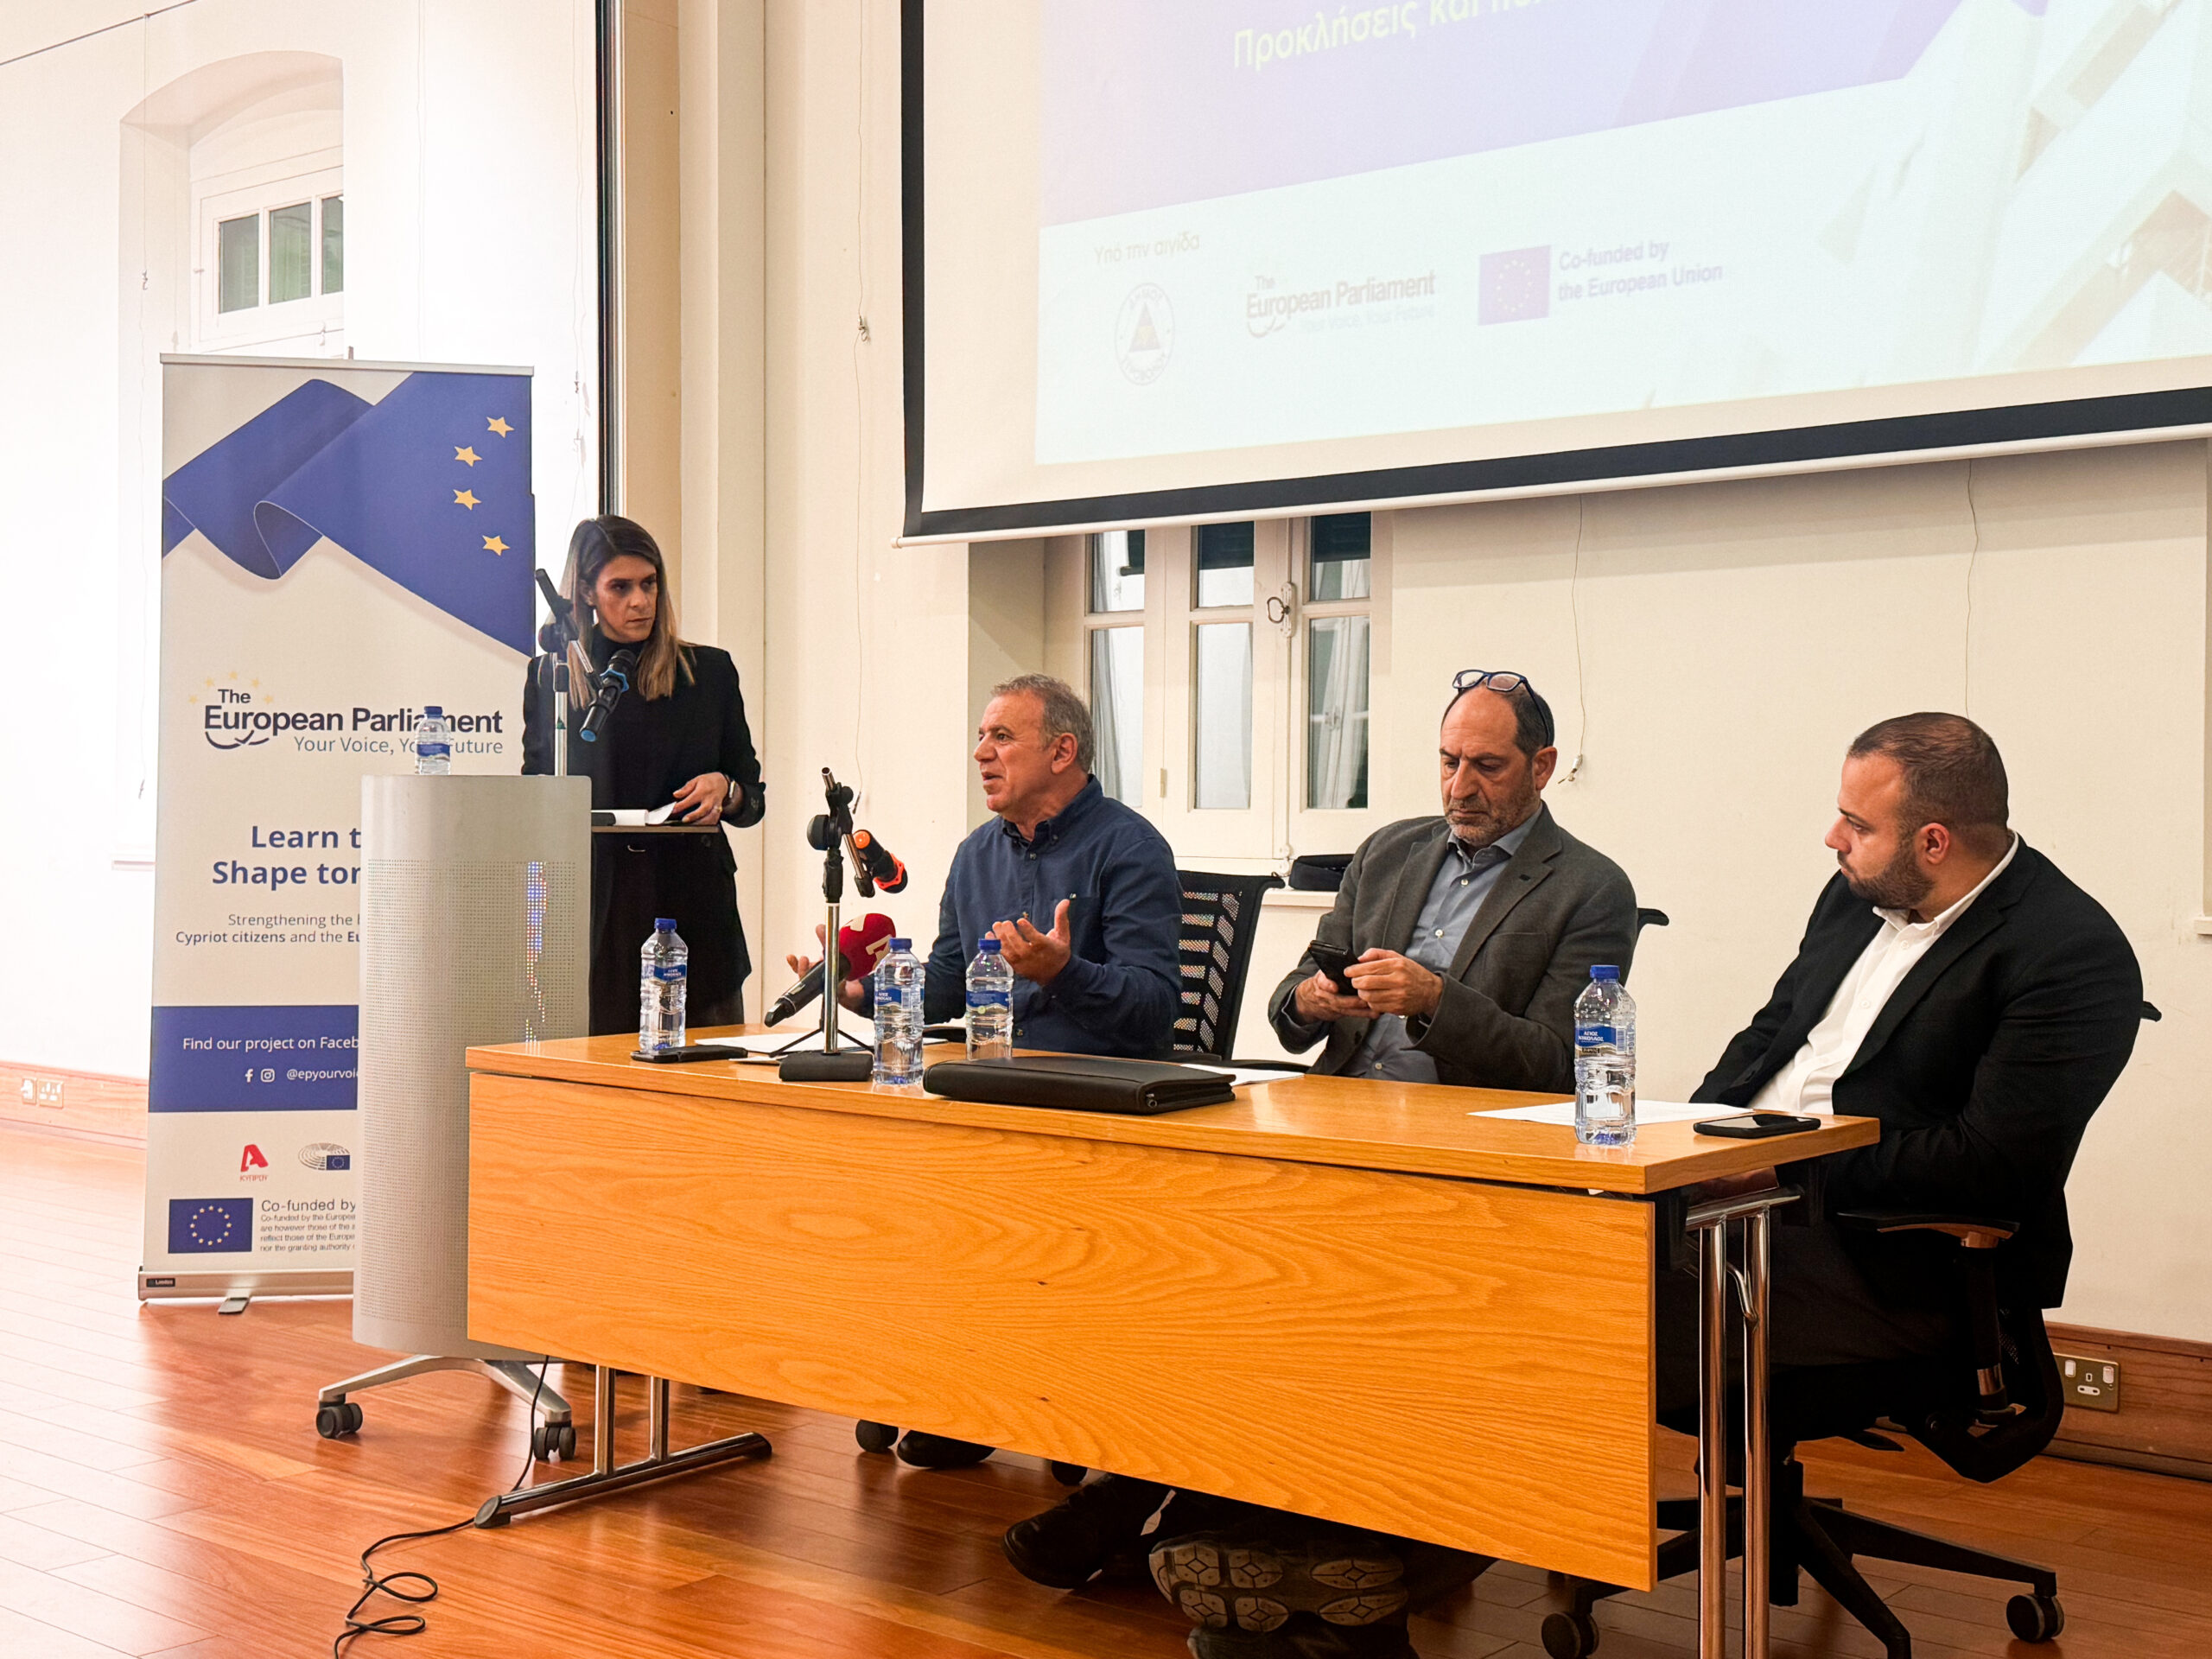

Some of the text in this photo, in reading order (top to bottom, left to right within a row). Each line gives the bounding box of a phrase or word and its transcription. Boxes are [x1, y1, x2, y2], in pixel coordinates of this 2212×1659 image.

[1233, 1, 1419, 72] Προκλήσεις
[1559, 238, 1670, 271] Co-funded by
[1254, 274, 1275, 291] The
[1558, 264, 1723, 302] the European Union
[1246, 270, 1436, 321] European Parliament
[218, 689, 251, 704] The
[205, 705, 344, 736] European
[294, 736, 335, 753] Your
[340, 736, 394, 755] Voice,
[448, 738, 503, 754] uture
[251, 825, 339, 849] Learn
[213, 860, 308, 891] Shape
[228, 913, 327, 929] Strengthening
[331, 913, 353, 925] the
[175, 931, 228, 946] Cypriot
[232, 931, 286, 944] citizens
[290, 931, 316, 943] and
[321, 931, 343, 943] the
[183, 1035, 359, 1052] Find our project on Faceb
[261, 1198, 356, 1212] Co-funded by
[261, 1213, 300, 1222] Co-funded
[301, 1213, 310, 1222] by
[326, 1212, 356, 1222] Europea
[275, 1224, 305, 1232] however
[284, 1233, 305, 1242] those
[288, 1243, 318, 1253] granting
[319, 1243, 351, 1252] authority
